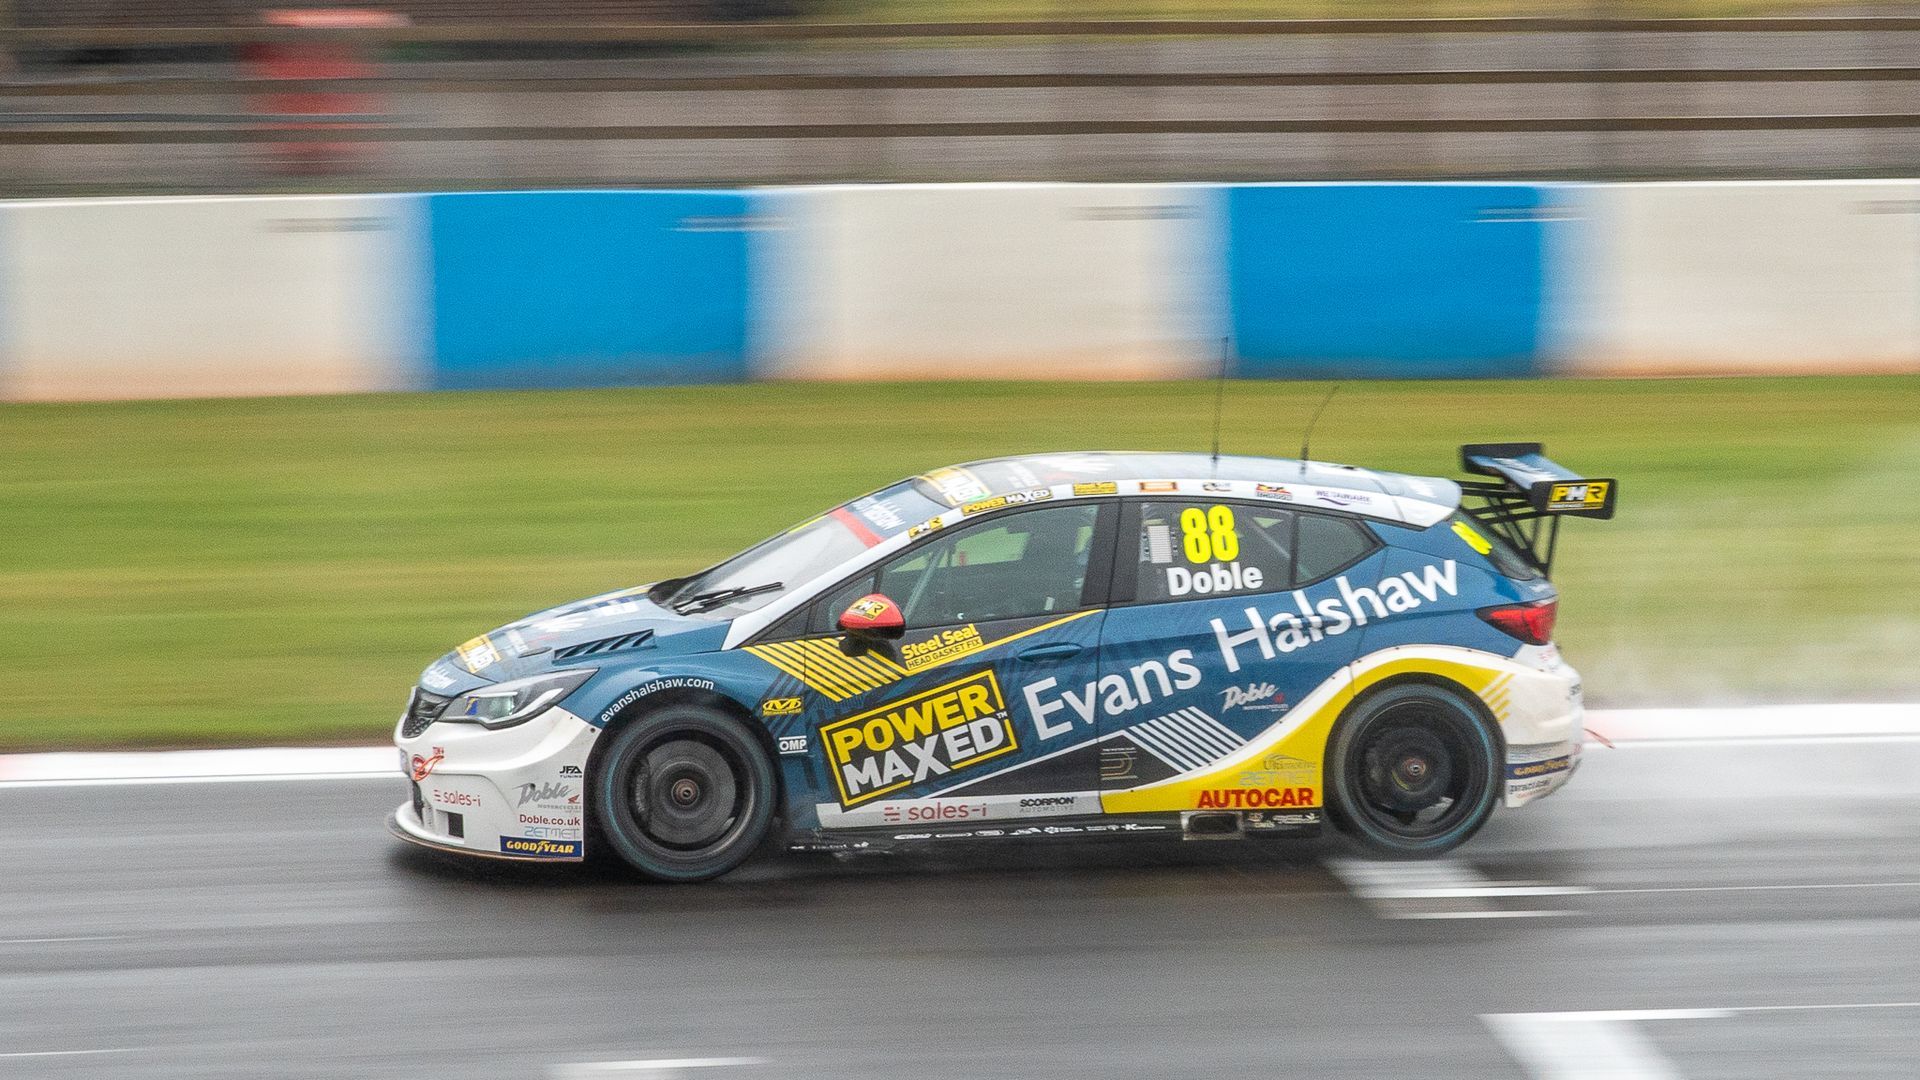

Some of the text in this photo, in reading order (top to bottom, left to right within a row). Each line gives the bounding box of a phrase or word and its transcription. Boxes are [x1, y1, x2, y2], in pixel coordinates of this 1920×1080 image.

[1553, 485, 1604, 502] PMR
[1180, 505, 1239, 563] 88
[1166, 562, 1263, 596] Doble
[901, 624, 979, 658] Steel Seal
[1023, 559, 1458, 740] Evans Halshaw
[908, 640, 981, 669] HEAD GASKET FIX
[600, 677, 715, 723] evanshalshaw.com
[1218, 682, 1280, 713] Doble
[832, 684, 996, 764] POWER
[780, 739, 807, 751] OMP
[842, 717, 1004, 796] MAXED
[559, 766, 582, 774] JFA
[444, 790, 481, 807] sales-i
[512, 782, 572, 807] Doble
[1020, 797, 1074, 807] SCORPION
[1198, 788, 1315, 809] AUTOCAR
[519, 814, 581, 826] Doble.co.uk
[908, 802, 987, 820] sales-i
[506, 840, 575, 854] GOODYEAR
